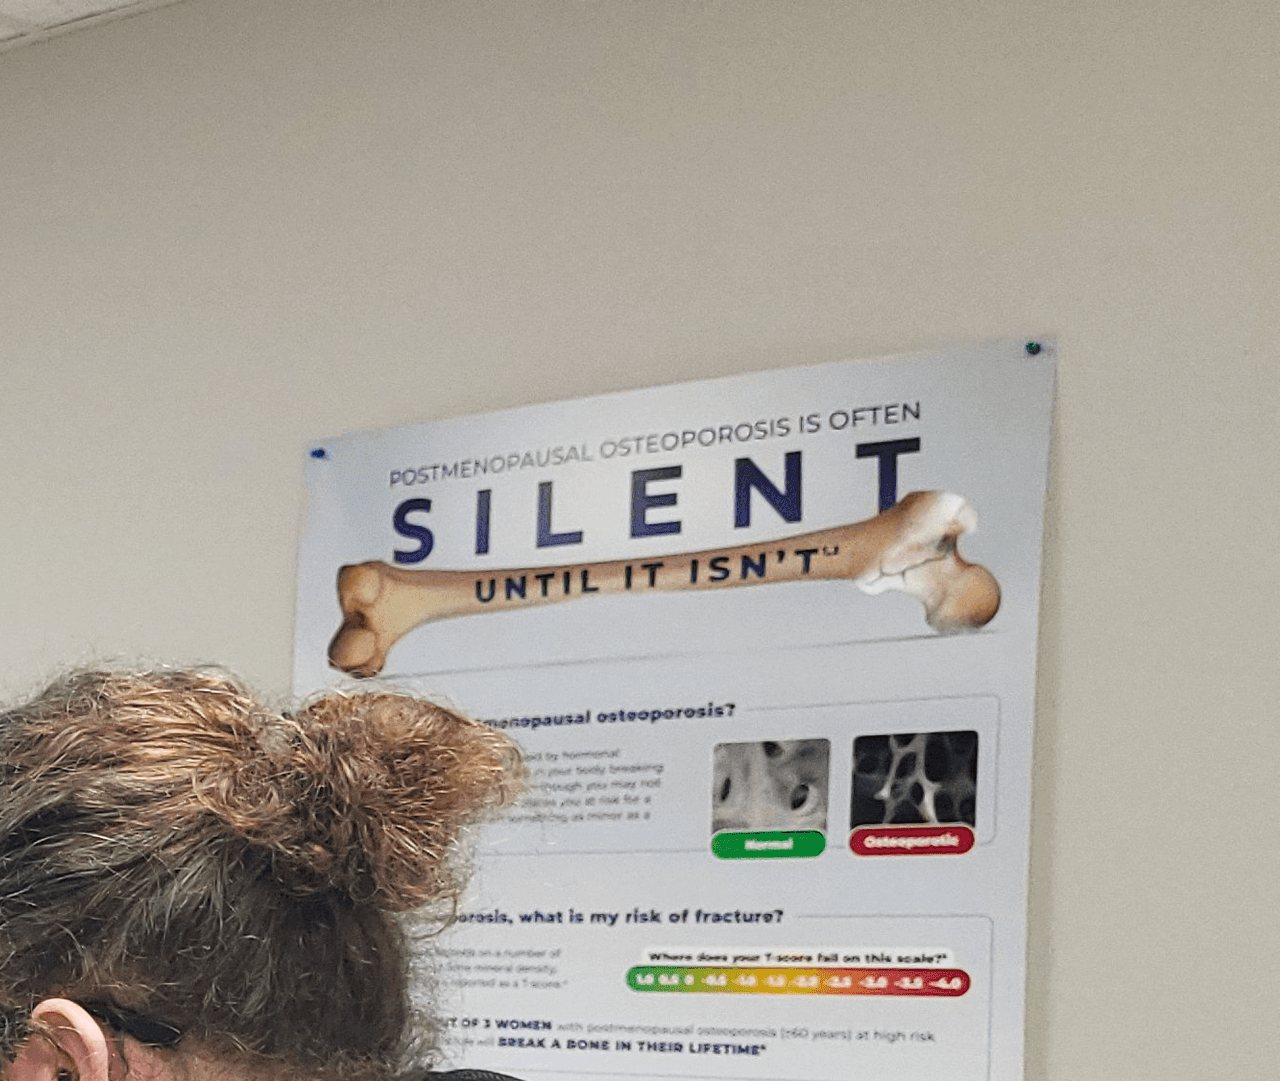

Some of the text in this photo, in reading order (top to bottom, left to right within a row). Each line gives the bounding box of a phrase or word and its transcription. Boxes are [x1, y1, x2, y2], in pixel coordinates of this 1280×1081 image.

[389, 401, 921, 487] POSTMENOPAUSAL OSTEOPOROSIS IS OFTEN
[391, 436, 921, 566] SILENT
[474, 569, 600, 604] UNTIL
[624, 561, 665, 590] IT
[480, 701, 736, 732] menopausal osteoporosis?
[519, 910, 563, 924] what
[568, 909, 583, 923] is
[590, 913, 618, 927] my
[625, 908, 661, 923] risk
[668, 909, 688, 923] of
[695, 908, 783, 924] fracture?
[495, 1019, 552, 1031] WOMEN
[615, 1040, 632, 1051] IN
